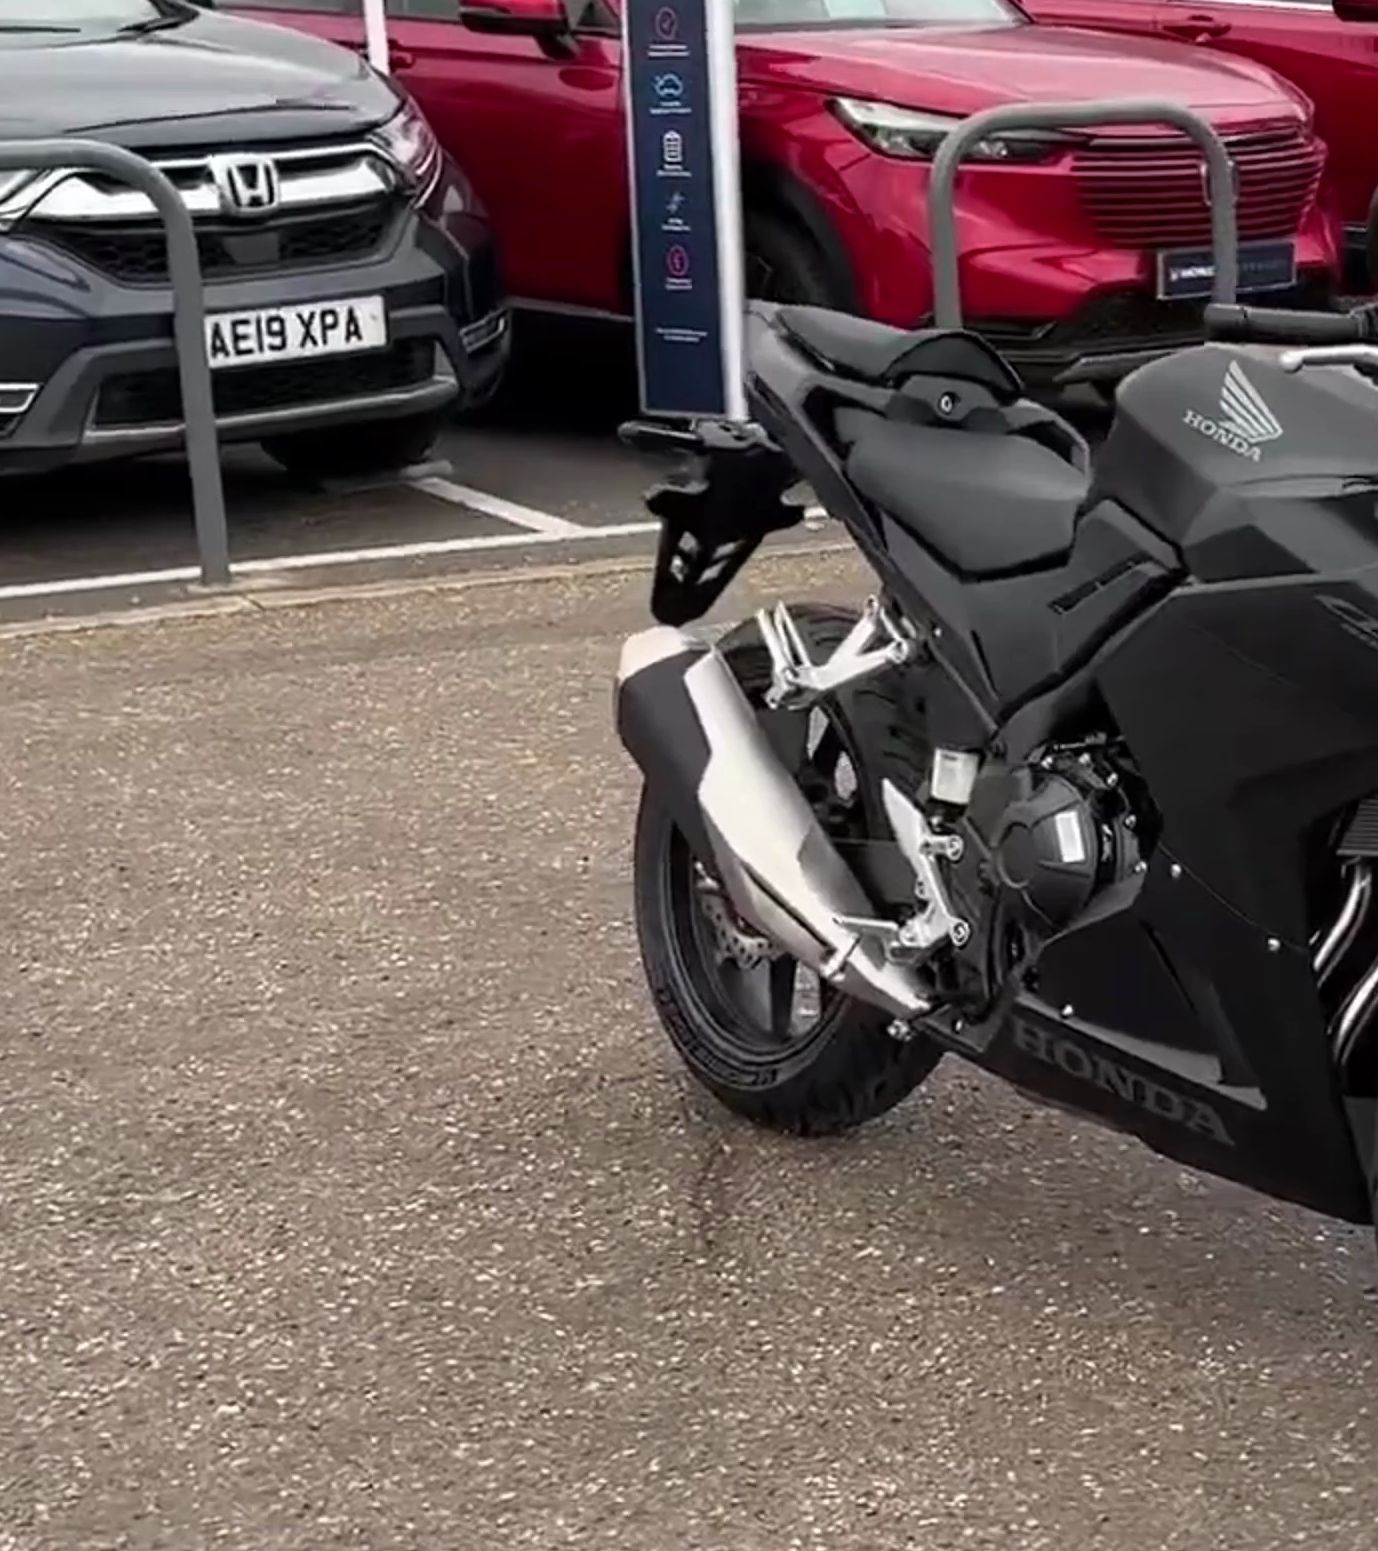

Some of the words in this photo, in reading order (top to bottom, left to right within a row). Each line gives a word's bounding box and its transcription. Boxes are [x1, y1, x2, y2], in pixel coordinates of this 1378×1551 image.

[211, 315, 288, 358] AE19
[296, 305, 363, 348] XPA
[1183, 409, 1261, 462] HONDA
[1012, 1018, 1236, 1147] HONDA
